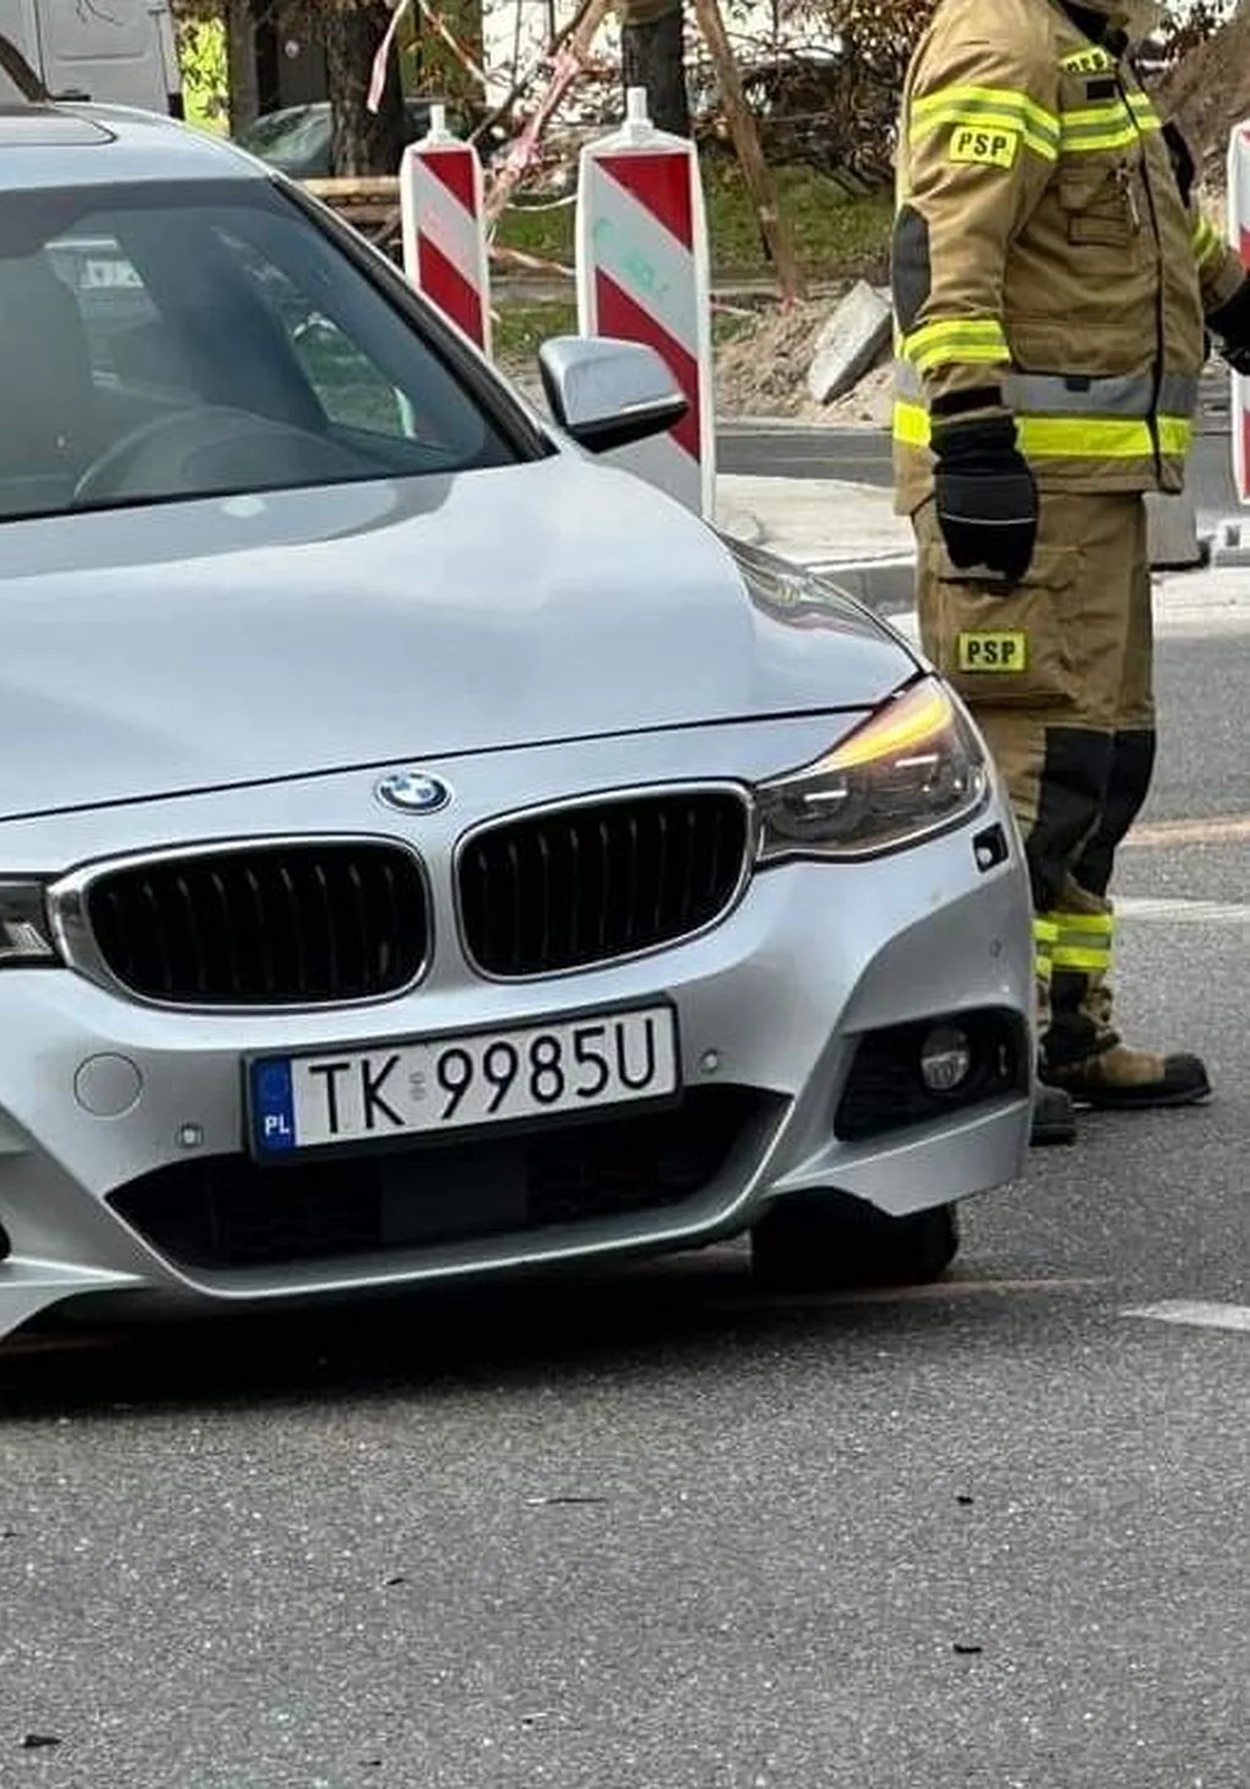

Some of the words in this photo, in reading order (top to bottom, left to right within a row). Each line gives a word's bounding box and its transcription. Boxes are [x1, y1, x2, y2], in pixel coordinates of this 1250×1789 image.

[956, 131, 1007, 156] PSP
[967, 640, 1015, 664] PSP
[309, 1055, 405, 1134] TK
[436, 1018, 656, 1120] 9985U
[265, 1113, 290, 1136] PL
